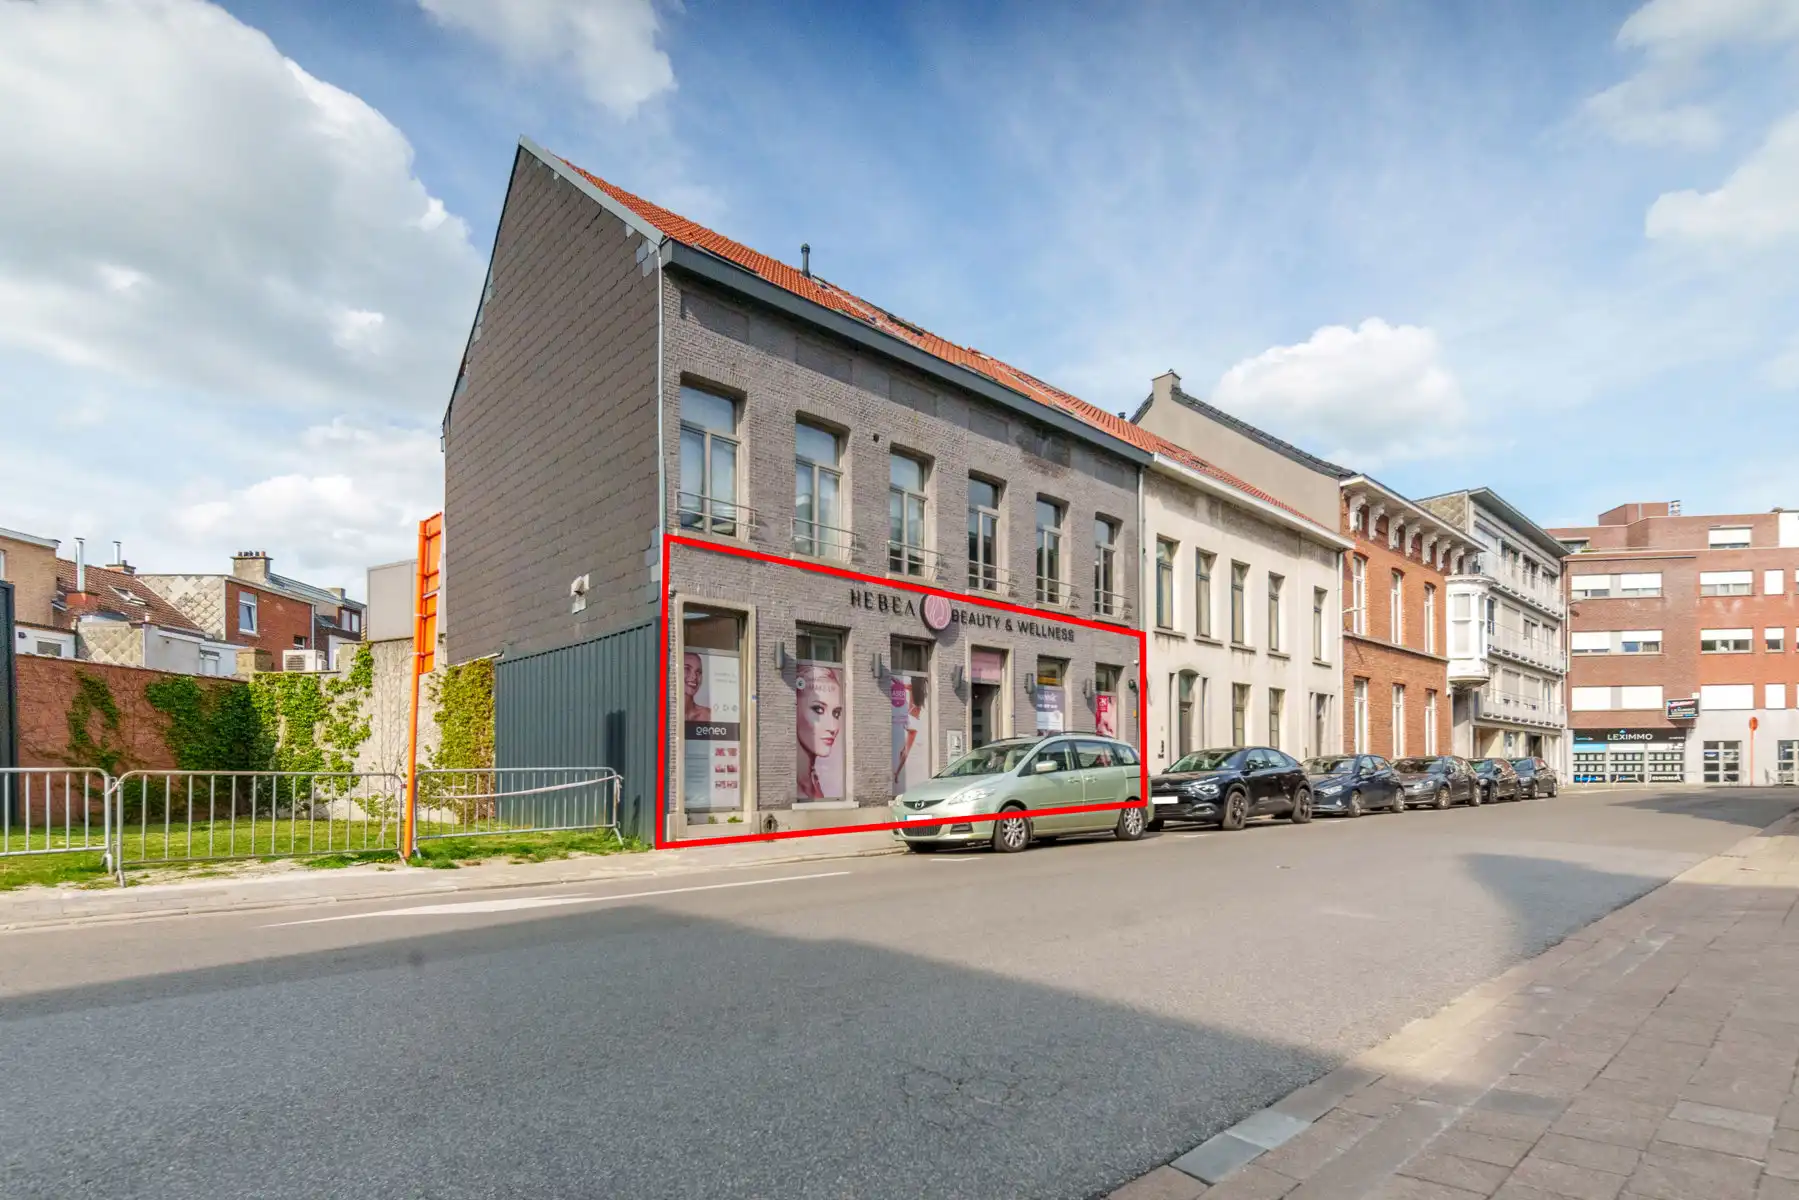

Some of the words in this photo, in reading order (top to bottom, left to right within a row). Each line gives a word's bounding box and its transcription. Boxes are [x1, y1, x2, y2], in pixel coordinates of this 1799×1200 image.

[850, 588, 916, 617] HEBEA
[952, 608, 1001, 630] BEAUTY
[1005, 618, 1013, 632] &
[1017, 620, 1075, 642] WELLNESS
[696, 727, 727, 736] geneo
[1607, 733, 1653, 741] LEXIMMO
